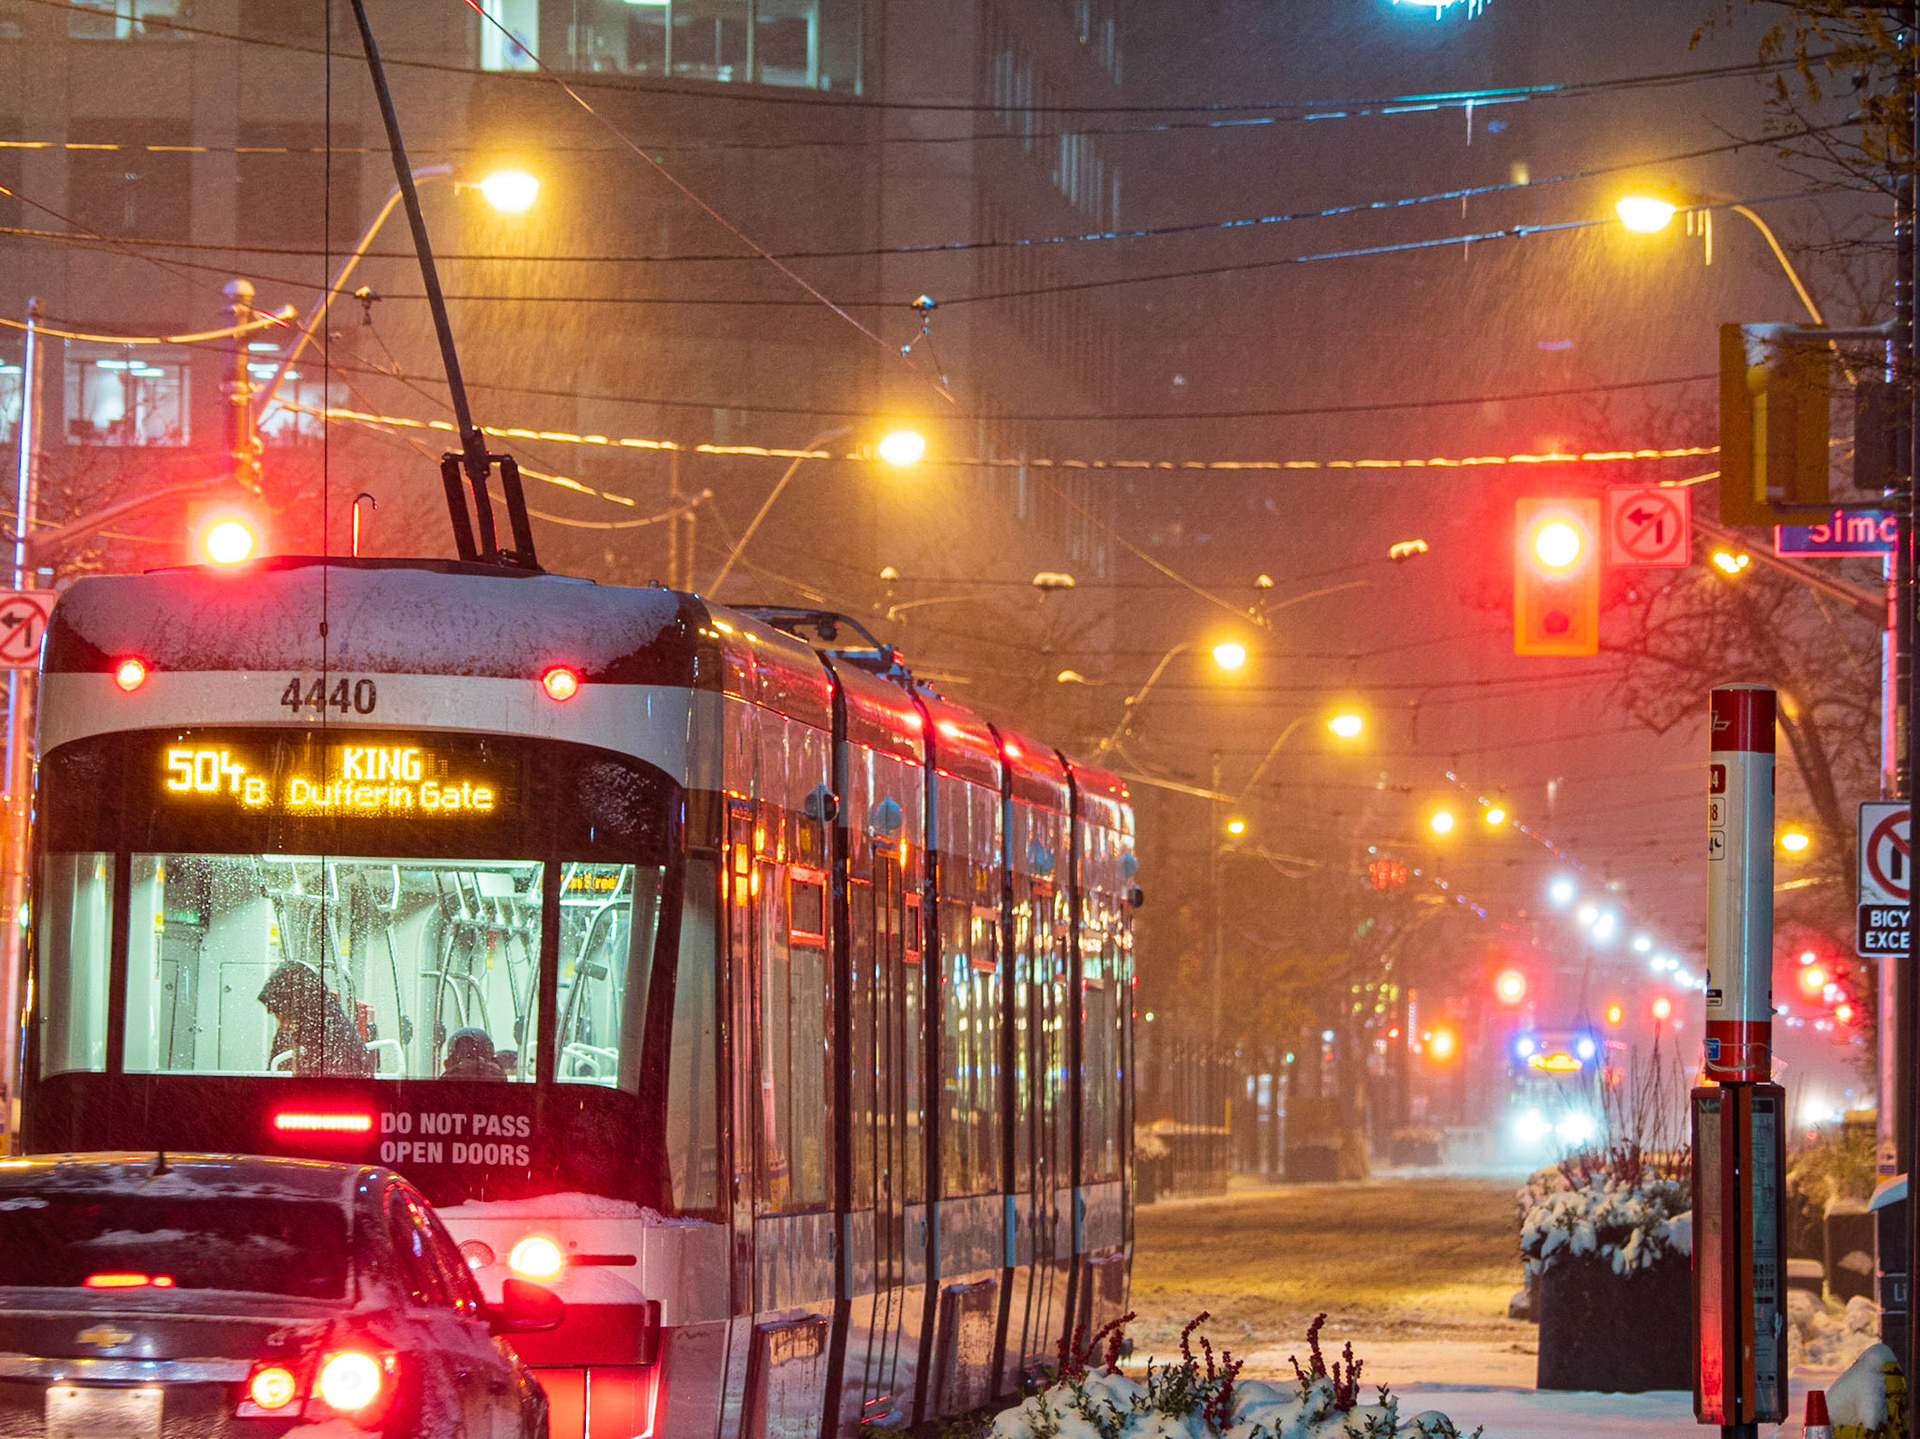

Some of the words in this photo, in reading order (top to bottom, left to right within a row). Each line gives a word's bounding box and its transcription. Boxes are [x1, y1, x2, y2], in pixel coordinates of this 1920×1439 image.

[281, 678, 377, 714] 4440
[343, 748, 421, 780] KING
[291, 779, 412, 806] Dufferin
[420, 782, 492, 808] Gate
[1870, 910, 1910, 928] BICY
[1865, 931, 1910, 949] EXCE
[380, 1112, 412, 1134] DO
[420, 1113, 466, 1135] NOT
[472, 1114, 530, 1137] PASS
[380, 1141, 443, 1163] OPEN
[452, 1142, 530, 1167] DOORS
